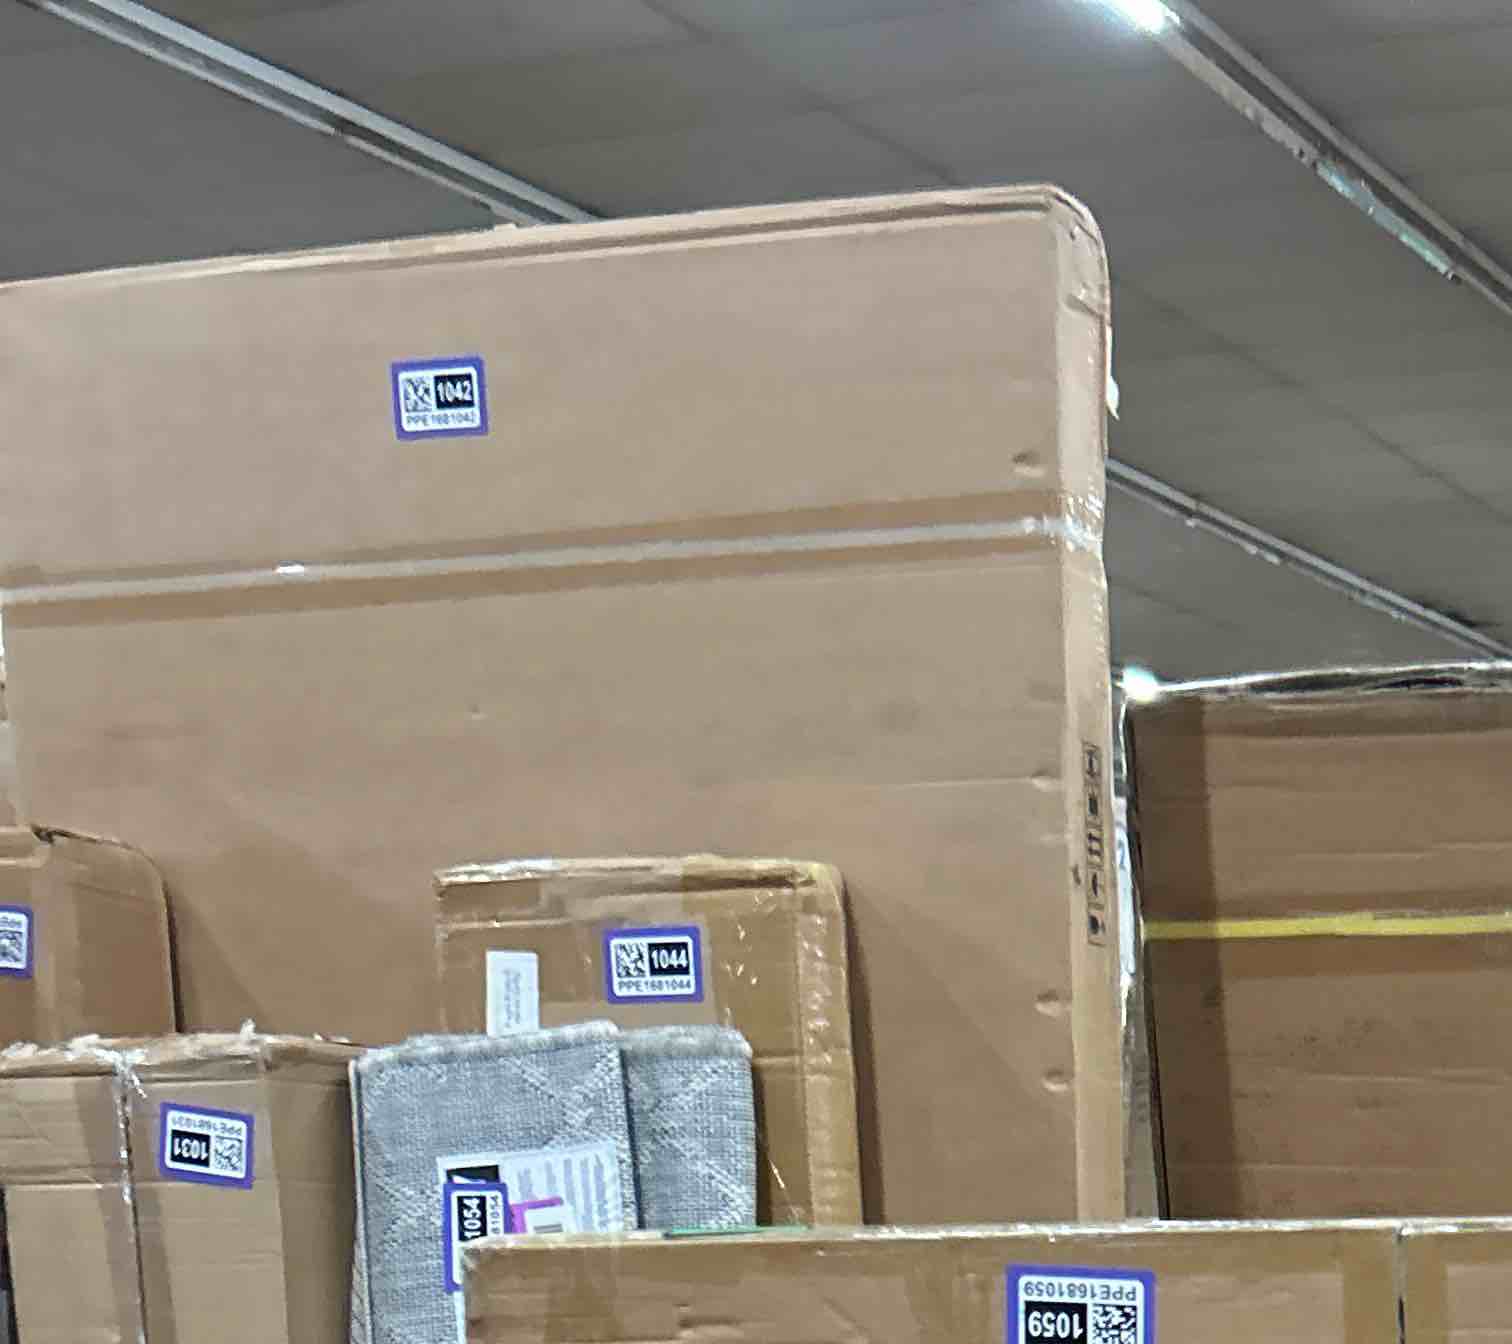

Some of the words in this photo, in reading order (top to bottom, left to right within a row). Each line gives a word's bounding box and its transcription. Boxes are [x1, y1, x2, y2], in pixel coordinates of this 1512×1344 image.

[437, 380, 473, 403] 1042
[651, 949, 689, 969] 1044
[173, 1137, 209, 1161] 1031
[462, 1197, 482, 1241] 1054
[1023, 1280, 1138, 1302] PPE1681059
[1027, 1310, 1084, 1339] 1059
